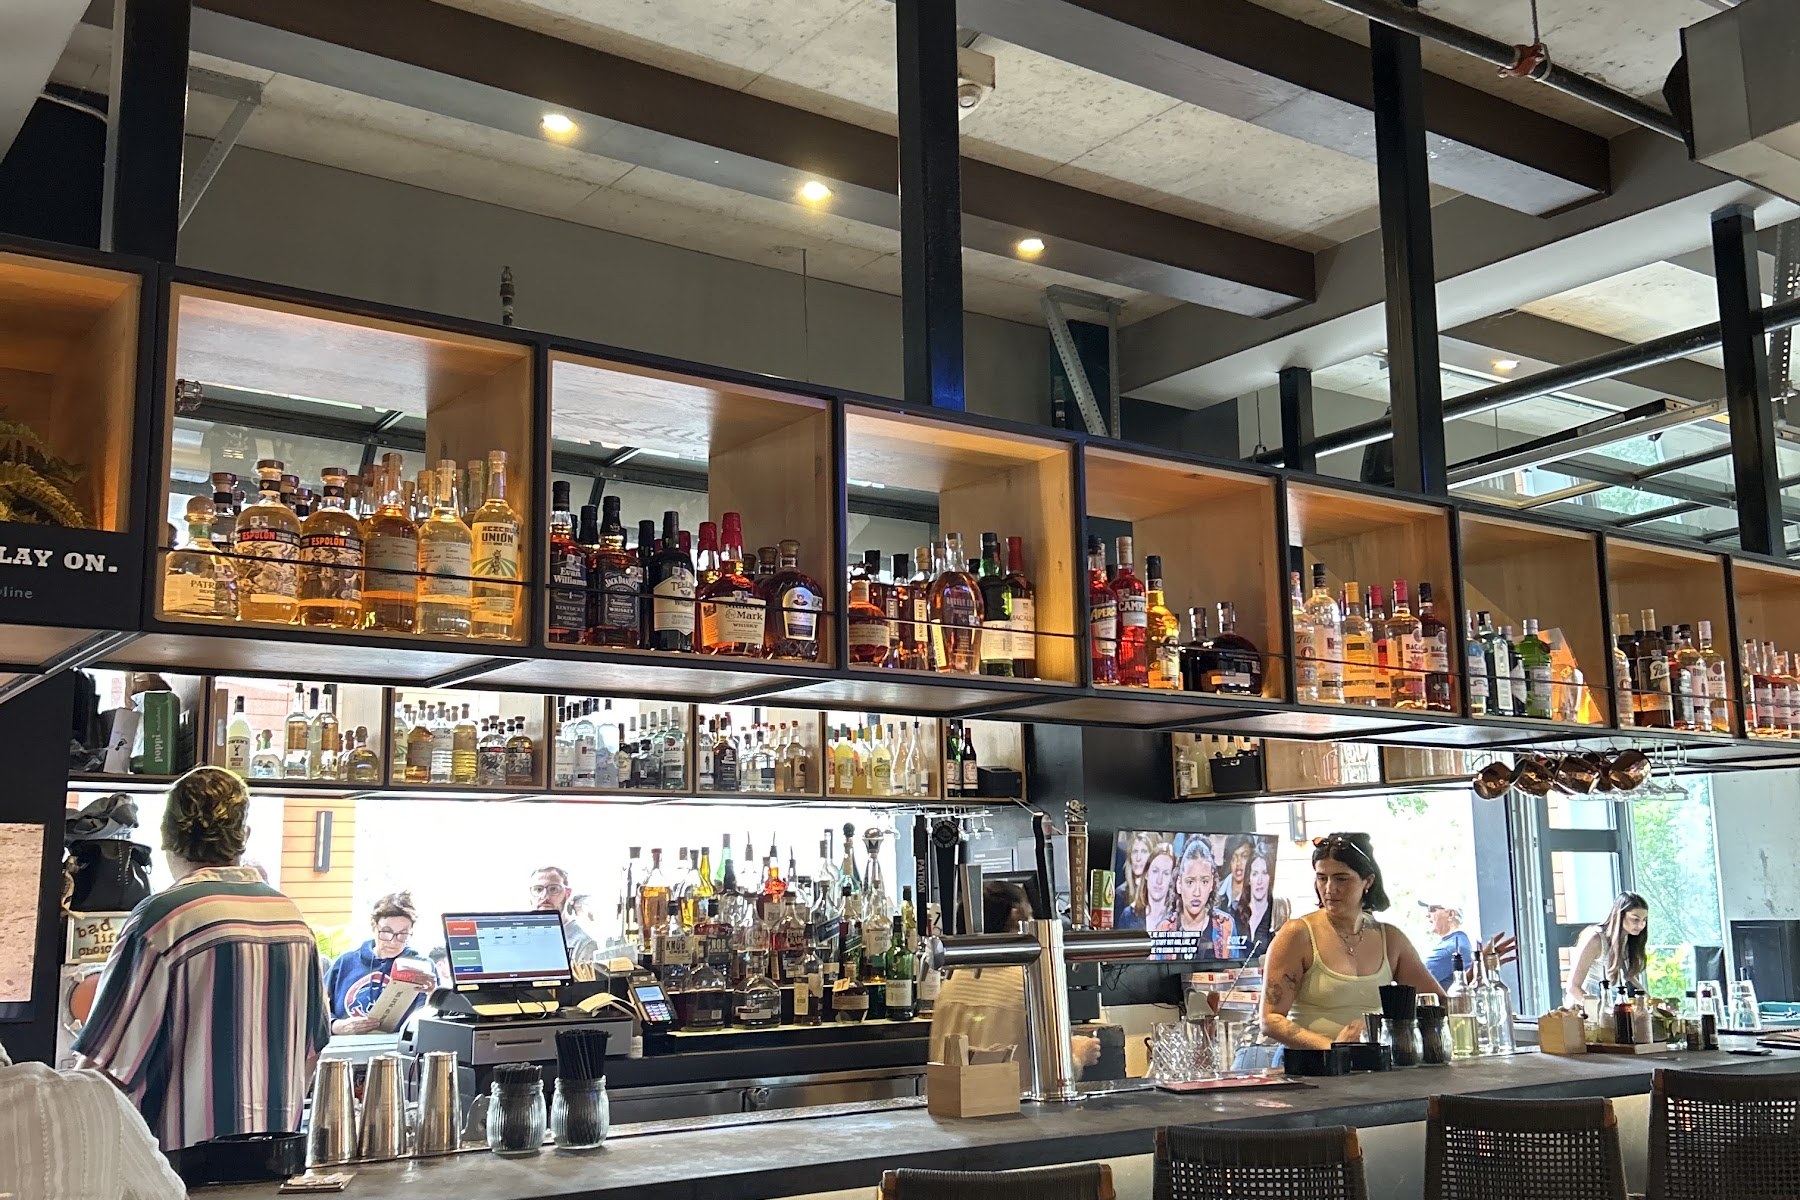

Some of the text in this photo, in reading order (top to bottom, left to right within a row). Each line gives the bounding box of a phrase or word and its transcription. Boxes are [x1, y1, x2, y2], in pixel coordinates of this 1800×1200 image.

[64, 552, 118, 573] ON.
[553, 574, 588, 586] Williams
[737, 610, 764, 622] Mark
[152, 734, 163, 763] poppi
[76, 917, 112, 938] bad
[94, 933, 116, 945] lif
